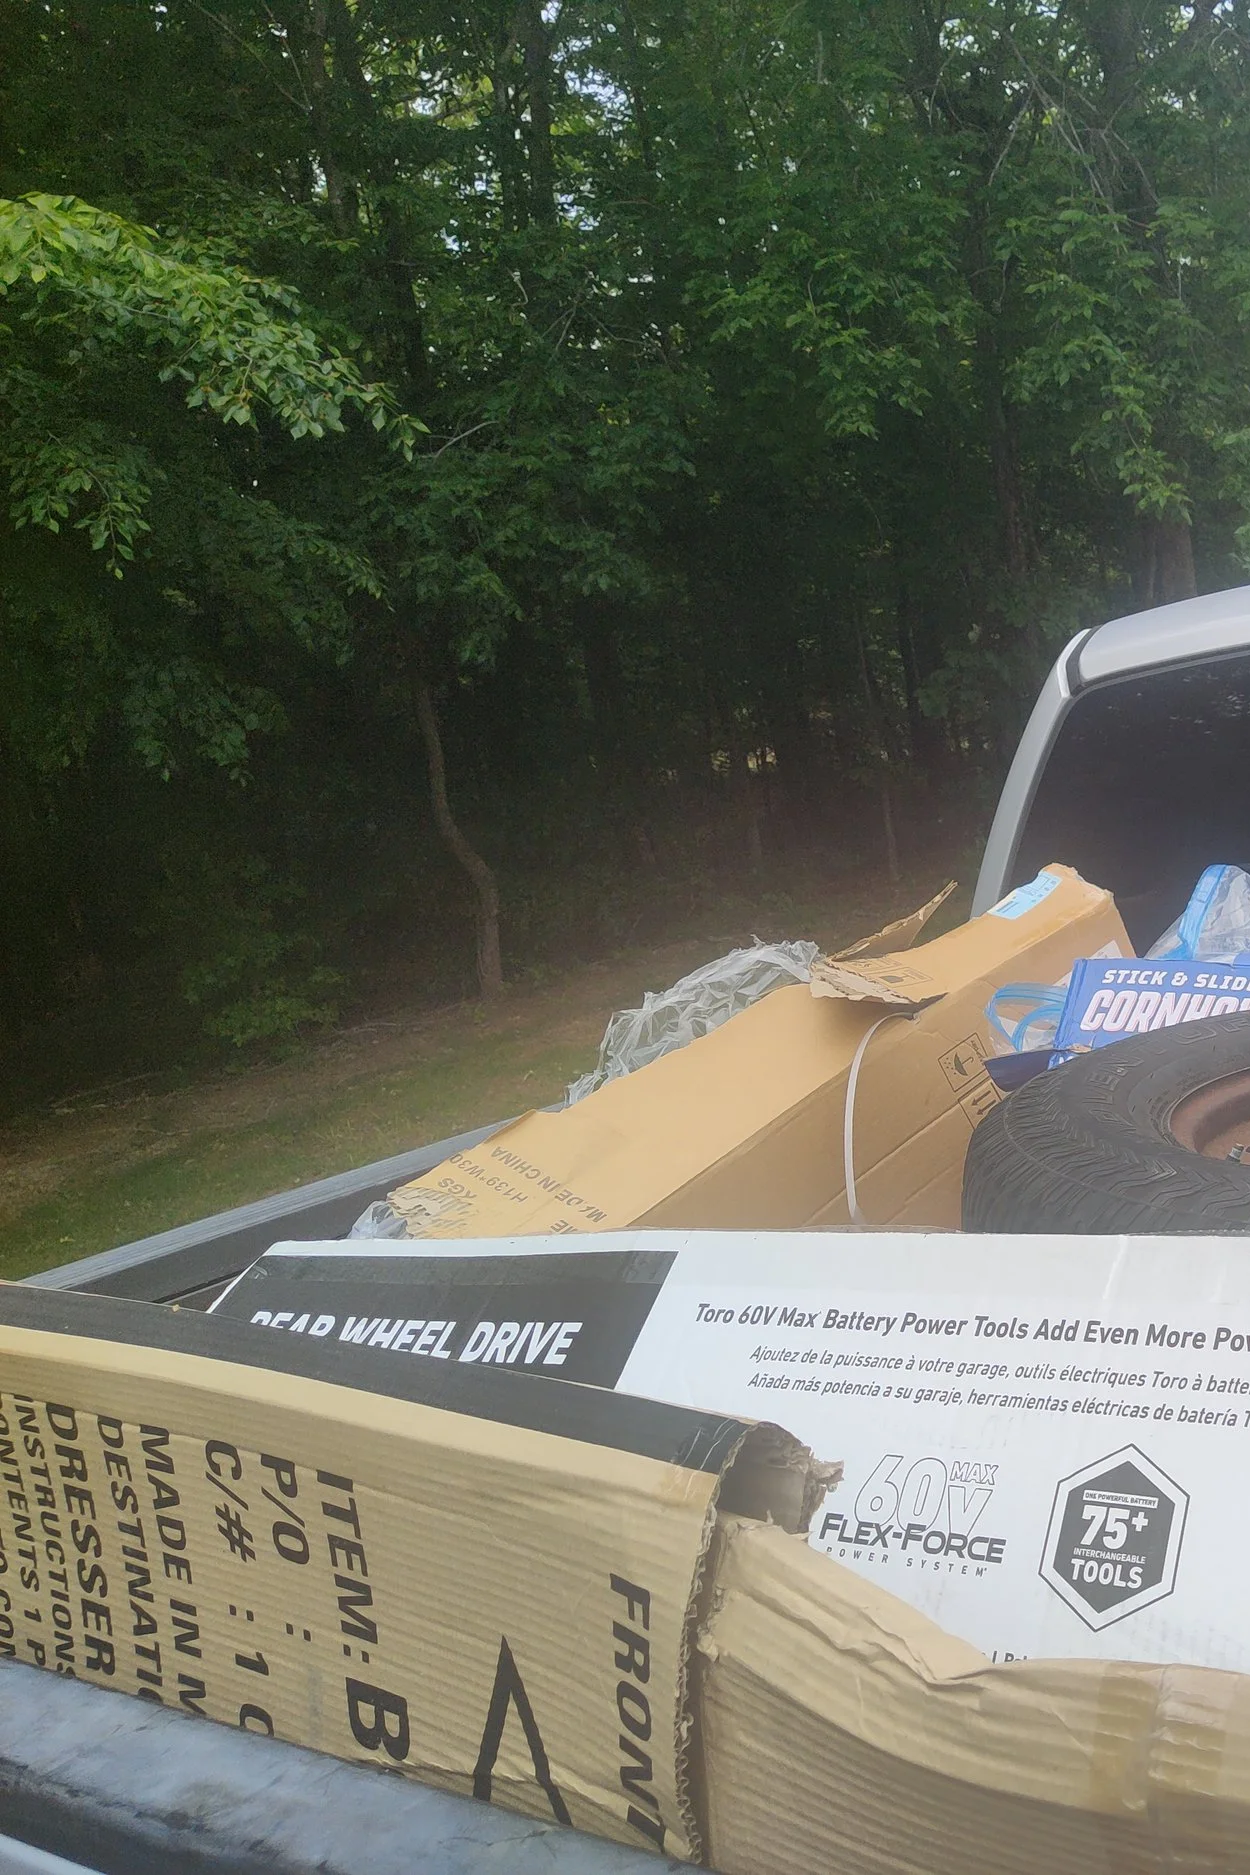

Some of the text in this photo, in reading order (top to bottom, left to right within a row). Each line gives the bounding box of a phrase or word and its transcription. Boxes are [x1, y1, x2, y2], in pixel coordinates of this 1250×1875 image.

[1101, 968, 1168, 987] STICK
[1170, 971, 1189, 987] &
[490, 1145, 541, 1180] CHINA
[537, 1175, 561, 1194] IN
[338, 1316, 456, 1360] WHEEL
[458, 1321, 583, 1365] DRIVE
[695, 1303, 734, 1324] Toro
[738, 1305, 779, 1326] 60V
[822, 1308, 897, 1337] Battery
[900, 1312, 968, 1337] Power
[973, 1315, 1029, 1340] Tools
[1032, 1318, 1079, 1343] Add
[1083, 1320, 1139, 1345] Even
[1145, 1323, 1206, 1349] More
[749, 1345, 800, 1364] Ajoutez
[800, 1348, 818, 1364] de
[819, 1349, 832, 1365] la
[833, 1351, 902, 1370] puissance
[904, 1354, 915, 1371] à
[916, 1356, 955, 1374] votre
[955, 1360, 1010, 1380] garage,
[1014, 1361, 1056, 1382] outils
[1059, 1364, 1146, 1388] électriques
[1151, 1370, 1188, 1391] Toro
[1191, 1374, 1202, 1392] à
[747, 1372, 790, 1391] Añada
[791, 1376, 821, 1393] más
[821, 1378, 880, 1398] potencia
[882, 1384, 892, 1398] a
[894, 1386, 912, 1400] su
[914, 1386, 963, 1406] garaje,
[966, 1391, 1069, 1413] herramientas
[1071, 1396, 1149, 1420] eléctricas
[1153, 1403, 1174, 1422] de
[1177, 1405, 1238, 1428] batería
[0, 1393, 40, 1592] ONTENTS
[205, 1439, 257, 1563] C/#
[260, 1452, 311, 1565] P/O
[854, 1454, 999, 1538] 60V MAX
[46, 1402, 116, 1676] DRESSER
[139, 1423, 193, 1585] MADE
[169, 1598, 202, 1659] IN
[818, 1512, 1007, 1564] FLEX-FORCE
[1080, 1504, 1149, 1550] 75+
[316, 1469, 378, 1664] ITEM:
[906, 1557, 984, 1577] SYSTEM
[1070, 1558, 1143, 1589] TOOLS
[1073, 1547, 1146, 1565] INTERCHANGEABLE
